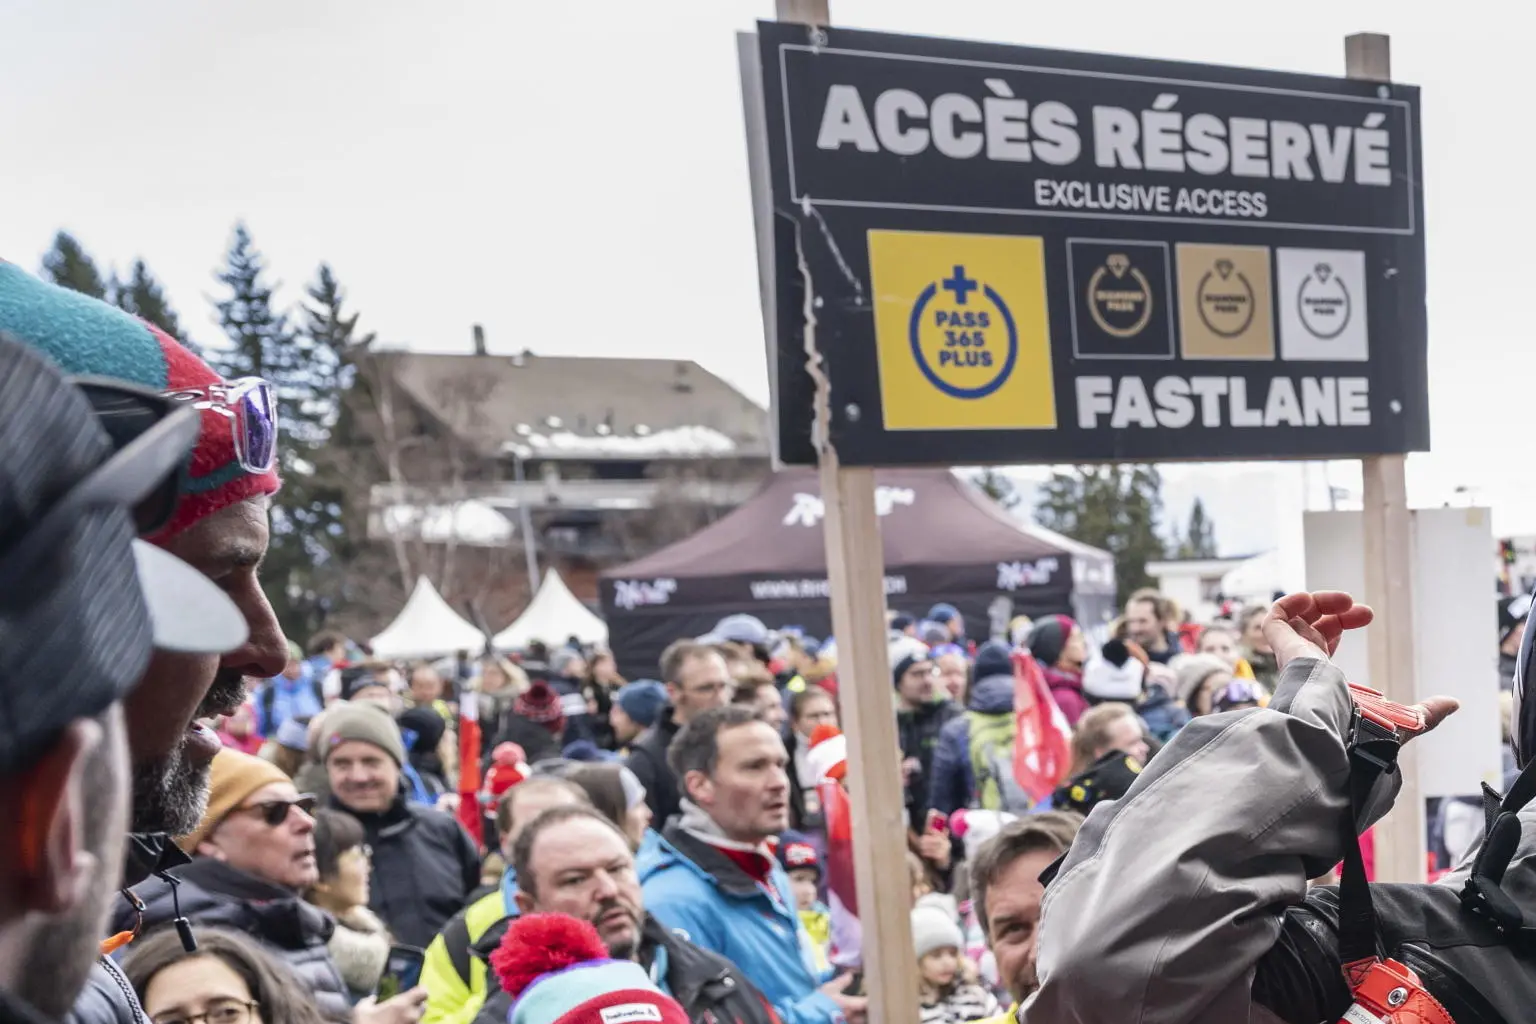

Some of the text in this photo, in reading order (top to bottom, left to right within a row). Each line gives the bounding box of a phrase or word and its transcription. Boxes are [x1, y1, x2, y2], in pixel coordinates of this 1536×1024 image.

[816, 78, 1392, 186] ACCÈS RÉSERVÉ
[1034, 178, 1268, 218] EXCLUSIVE ACCESS
[935, 310, 991, 328] PASS
[944, 330, 985, 347] 365
[939, 350, 993, 367] PLUS
[1074, 375, 1372, 429] FASTLANE
